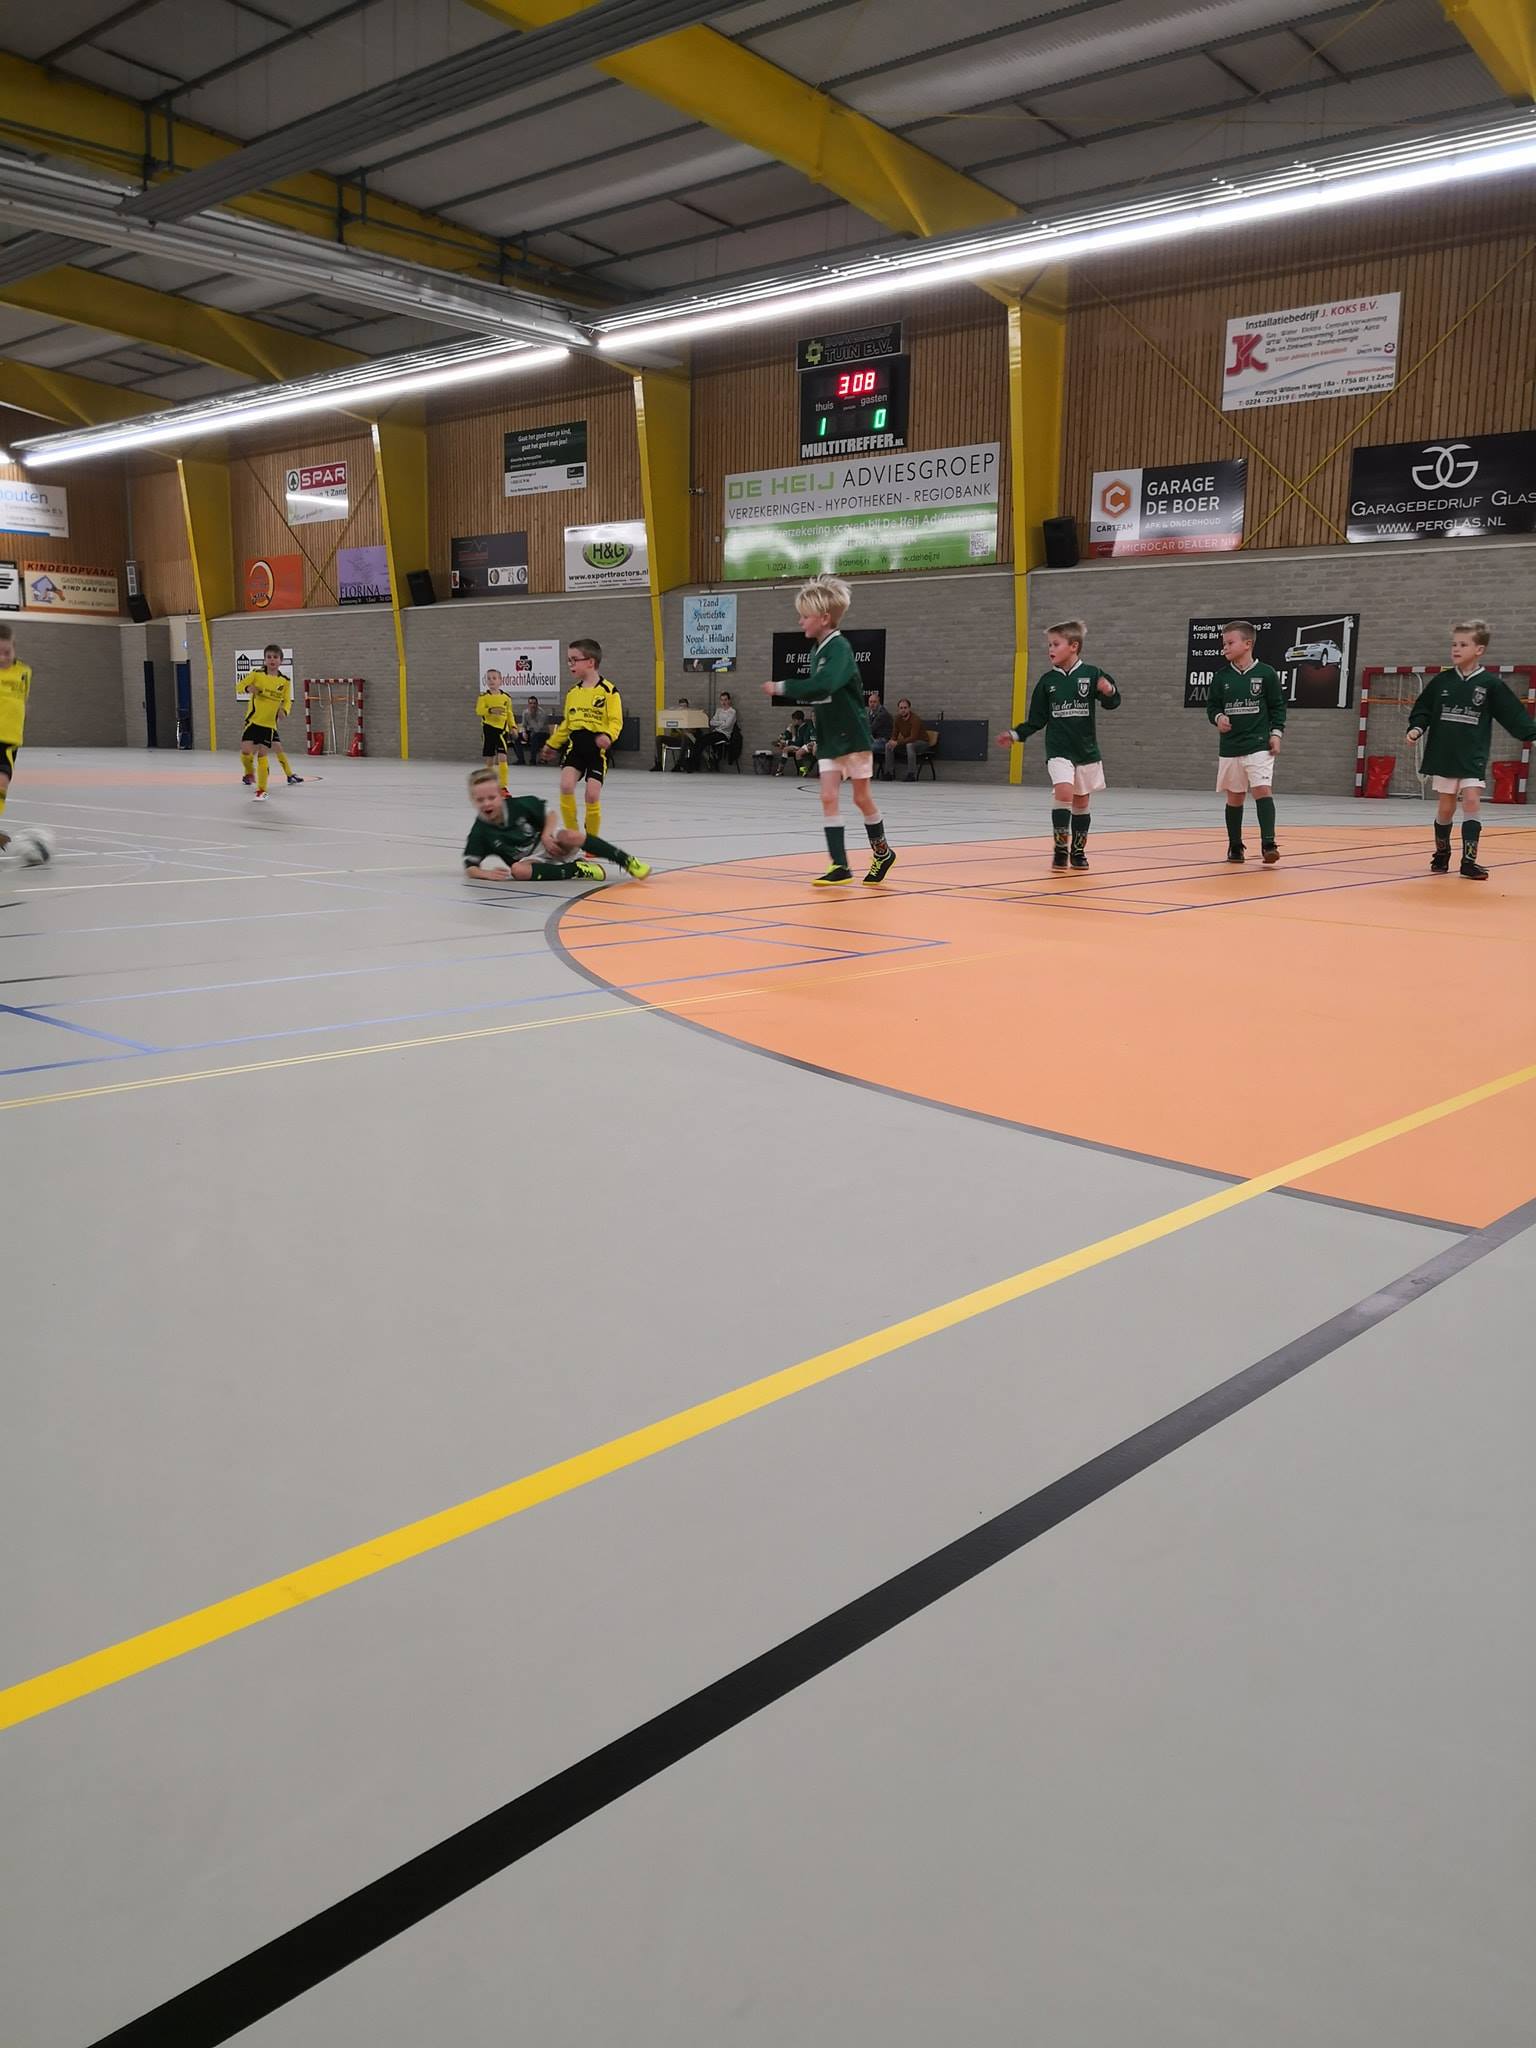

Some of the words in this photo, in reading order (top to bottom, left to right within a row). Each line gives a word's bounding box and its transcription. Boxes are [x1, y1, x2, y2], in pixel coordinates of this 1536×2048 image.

[1245, 310, 1319, 330] Installatiebedrijf
[1320, 309, 1327, 319] J.
[1330, 303, 1357, 316] KOKS
[1359, 301, 1379, 312] B.V.
[825, 344, 860, 363] TUIN
[864, 338, 893, 357] B.V.
[1376, 373, 1394, 381] Zand
[816, 401, 834, 412] thuis
[860, 394, 888, 407] gasten
[1245, 397, 1261, 406] 0224
[820, 417, 827, 436] 1
[874, 408, 887, 429] 0
[301, 466, 346, 487] SPAR
[728, 479, 762, 500] DE
[771, 471, 834, 496] HEIJ
[842, 452, 995, 489] ADVIESGROEP
[330, 487, 347, 497] Zand
[1147, 476, 1215, 497] GARAGE
[729, 501, 815, 520] VERZEKERINGEN
[825, 492, 902, 512] HYPOTHEKEN
[913, 482, 991, 503] REGIOBANK
[1145, 500, 1167, 516] DE
[1173, 496, 1220, 513] BOER
[883, 518, 897, 529] De
[1096, 522, 1134, 533] CARTEAM
[1170, 517, 1221, 528] ONDERHOUD
[1122, 539, 1175, 552] MICROCAR
[1177, 537, 1217, 549] DEALER
[592, 542, 625, 560] H&G
[27, 562, 115, 578] KINDEROPVANG
[568, 568, 649, 581] www.exporttractors.nl
[62, 584, 81, 593] KIND
[340, 584, 381, 599] FLORINA
[703, 597, 720, 608] Zand
[696, 622, 710, 633] dorp
[711, 623, 723, 631] van
[1193, 624, 1216, 632] Koning
[1262, 622, 1272, 630] 22
[1193, 632, 1208, 640] 1756
[785, 653, 796, 663] DE
[1191, 649, 1203, 657] Tel:
[1061, 700, 1072, 710] der
[1233, 698, 1243, 707] der
